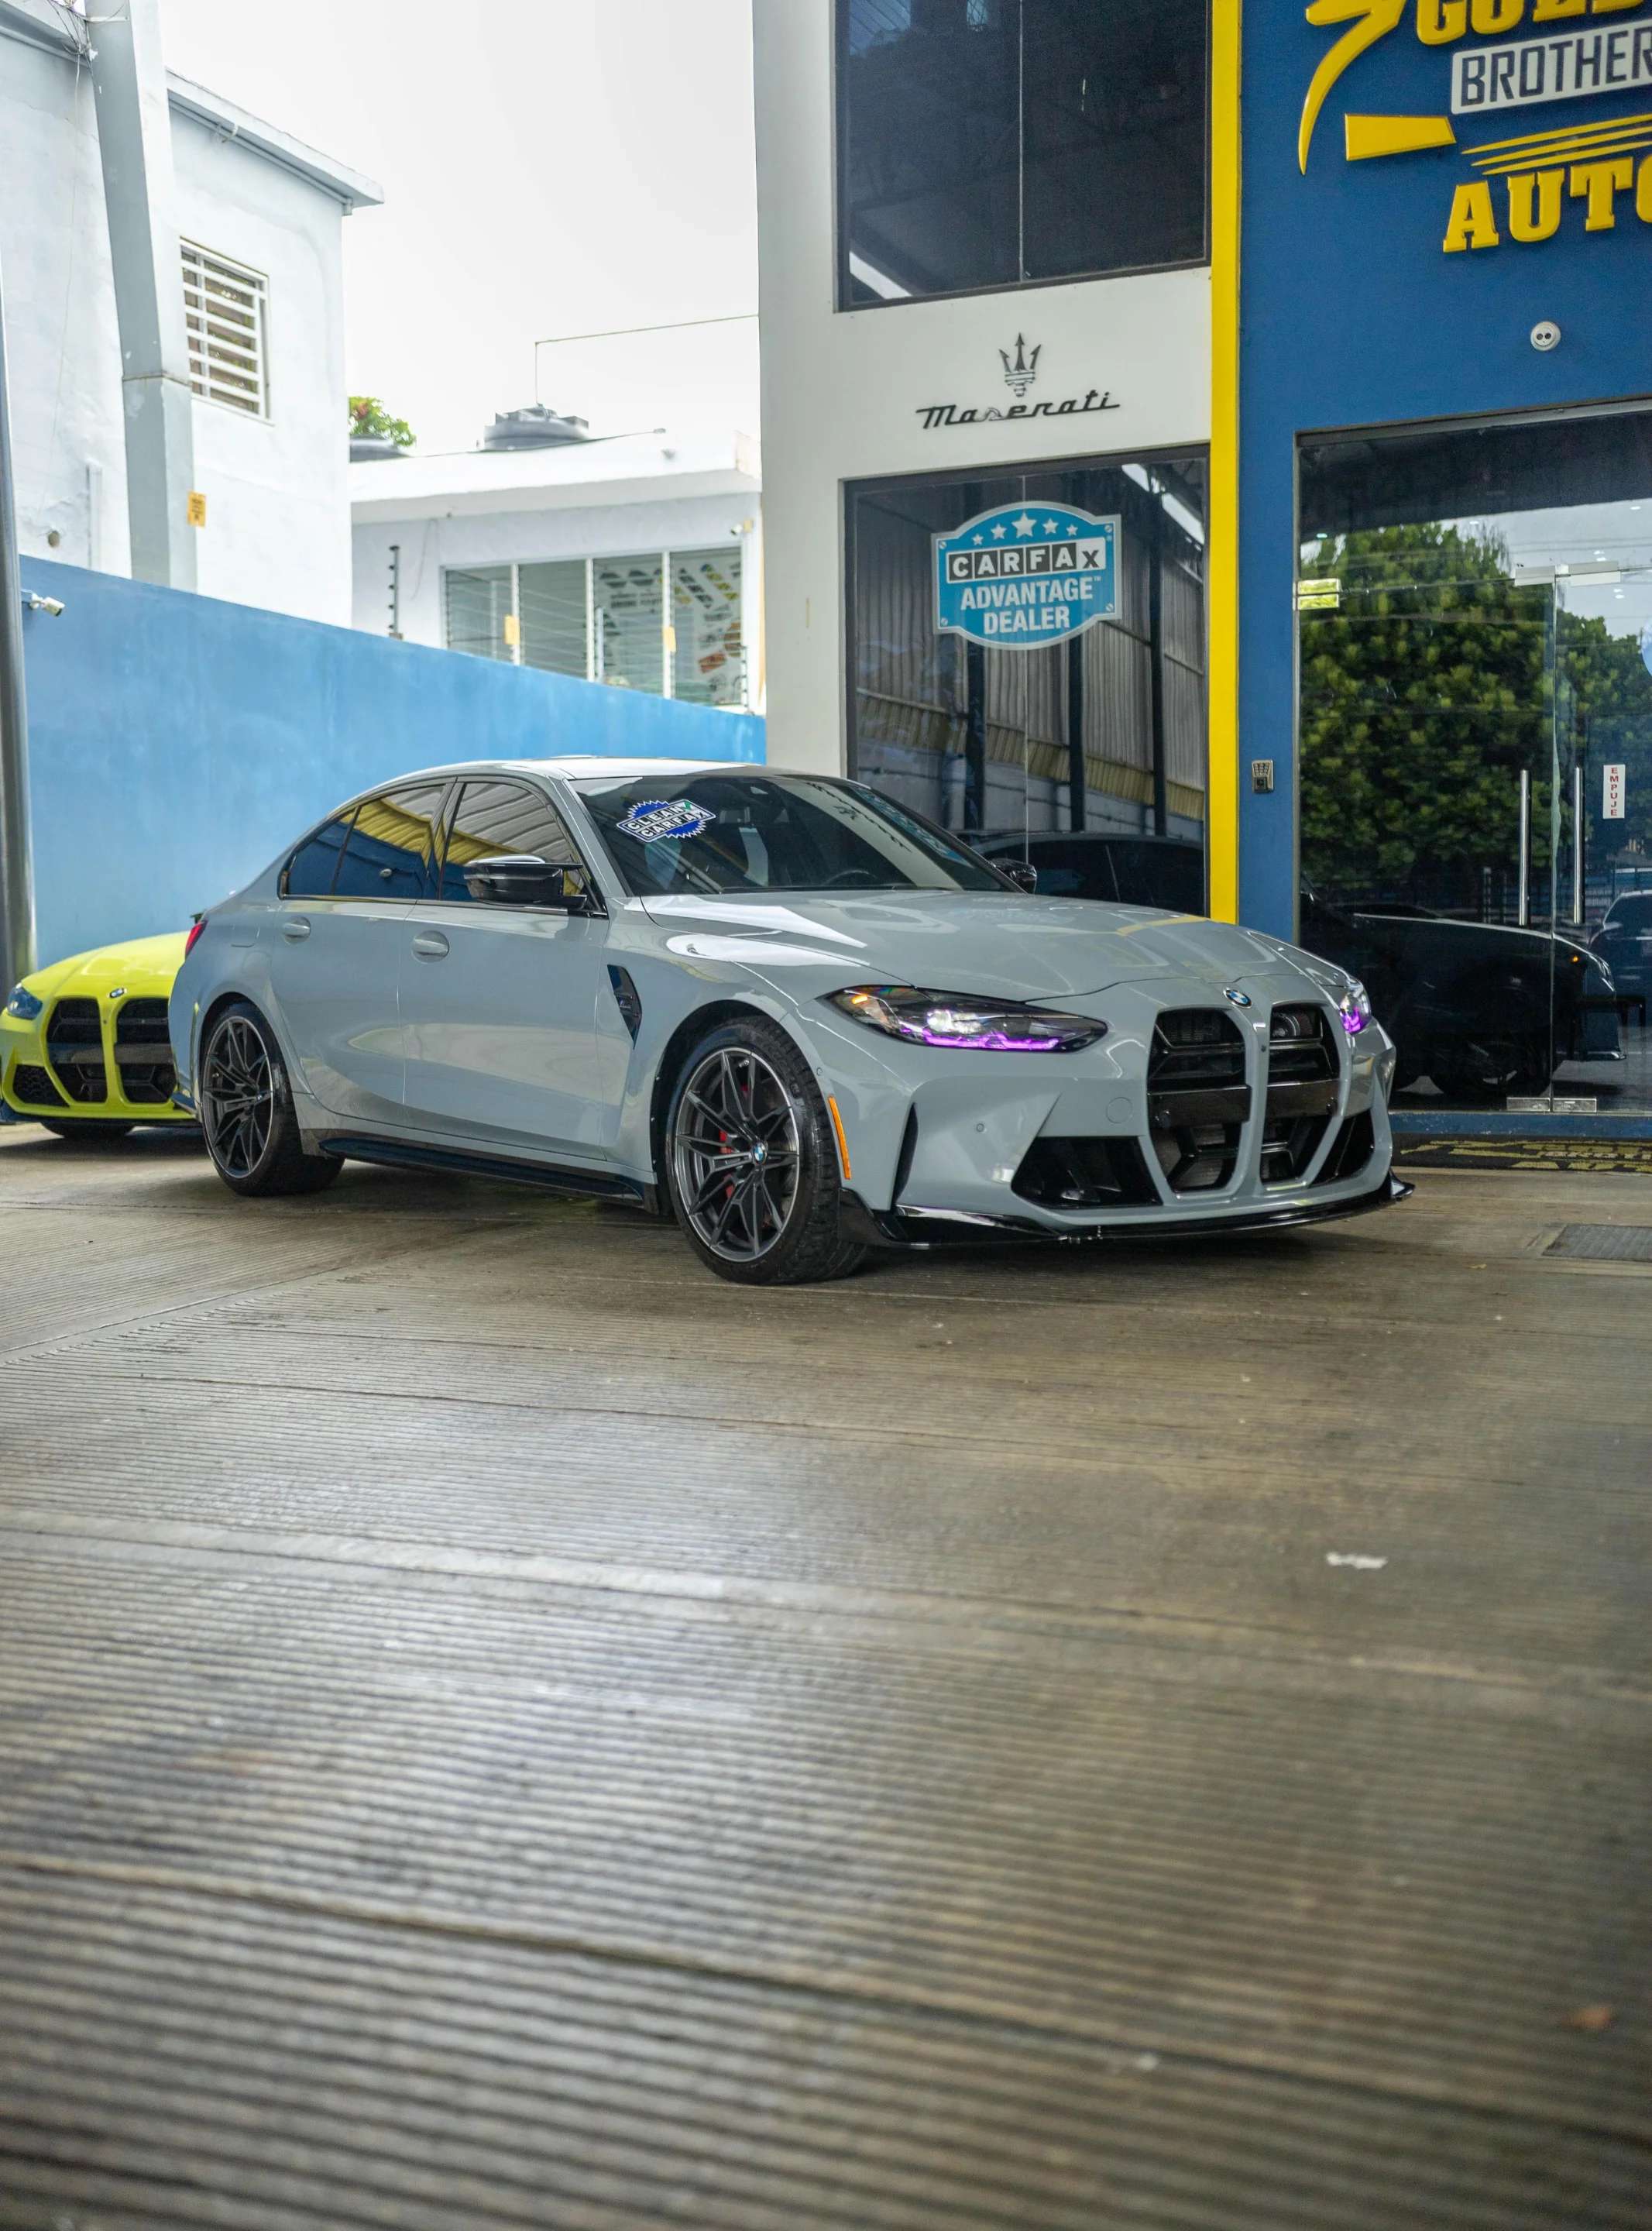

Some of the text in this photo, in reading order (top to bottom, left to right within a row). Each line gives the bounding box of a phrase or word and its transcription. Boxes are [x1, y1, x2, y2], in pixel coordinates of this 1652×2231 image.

[1460, 26, 1652, 107] BROTHER
[952, 547, 1099, 578] CARFAX
[984, 606, 1070, 634] DEALER
[1609, 767, 1619, 816] EMPUJE
[627, 805, 684, 830] CLEAN
[641, 812, 709, 837] CARFAX
